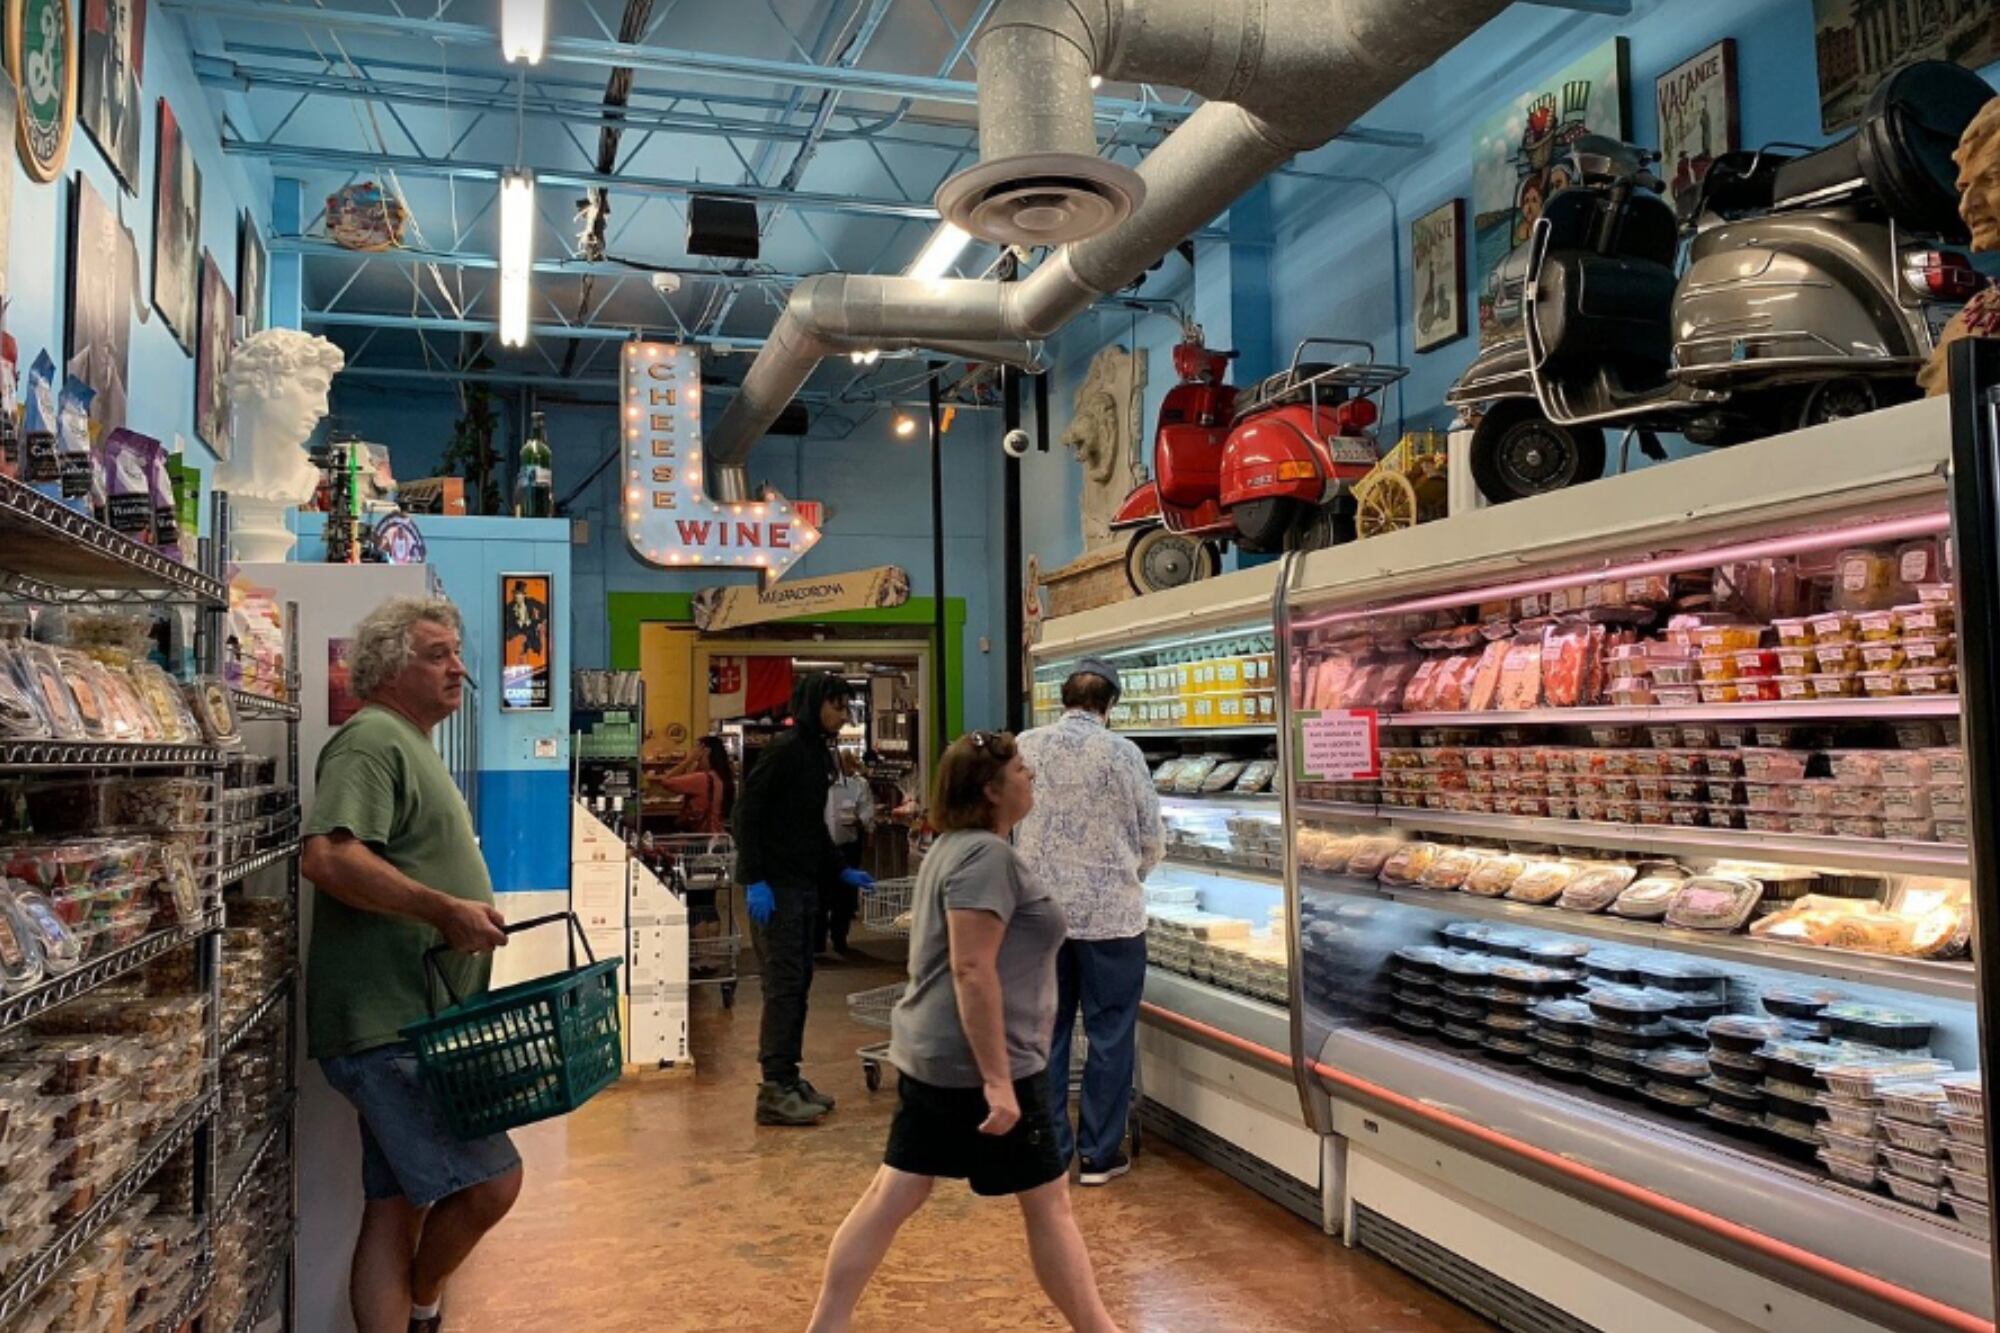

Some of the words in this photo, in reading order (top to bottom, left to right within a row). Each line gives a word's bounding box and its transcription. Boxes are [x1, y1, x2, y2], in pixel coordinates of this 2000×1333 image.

[1658, 54, 1720, 121] VACANZE
[647, 363, 677, 510] CHEESE
[674, 519, 791, 549] WINE
